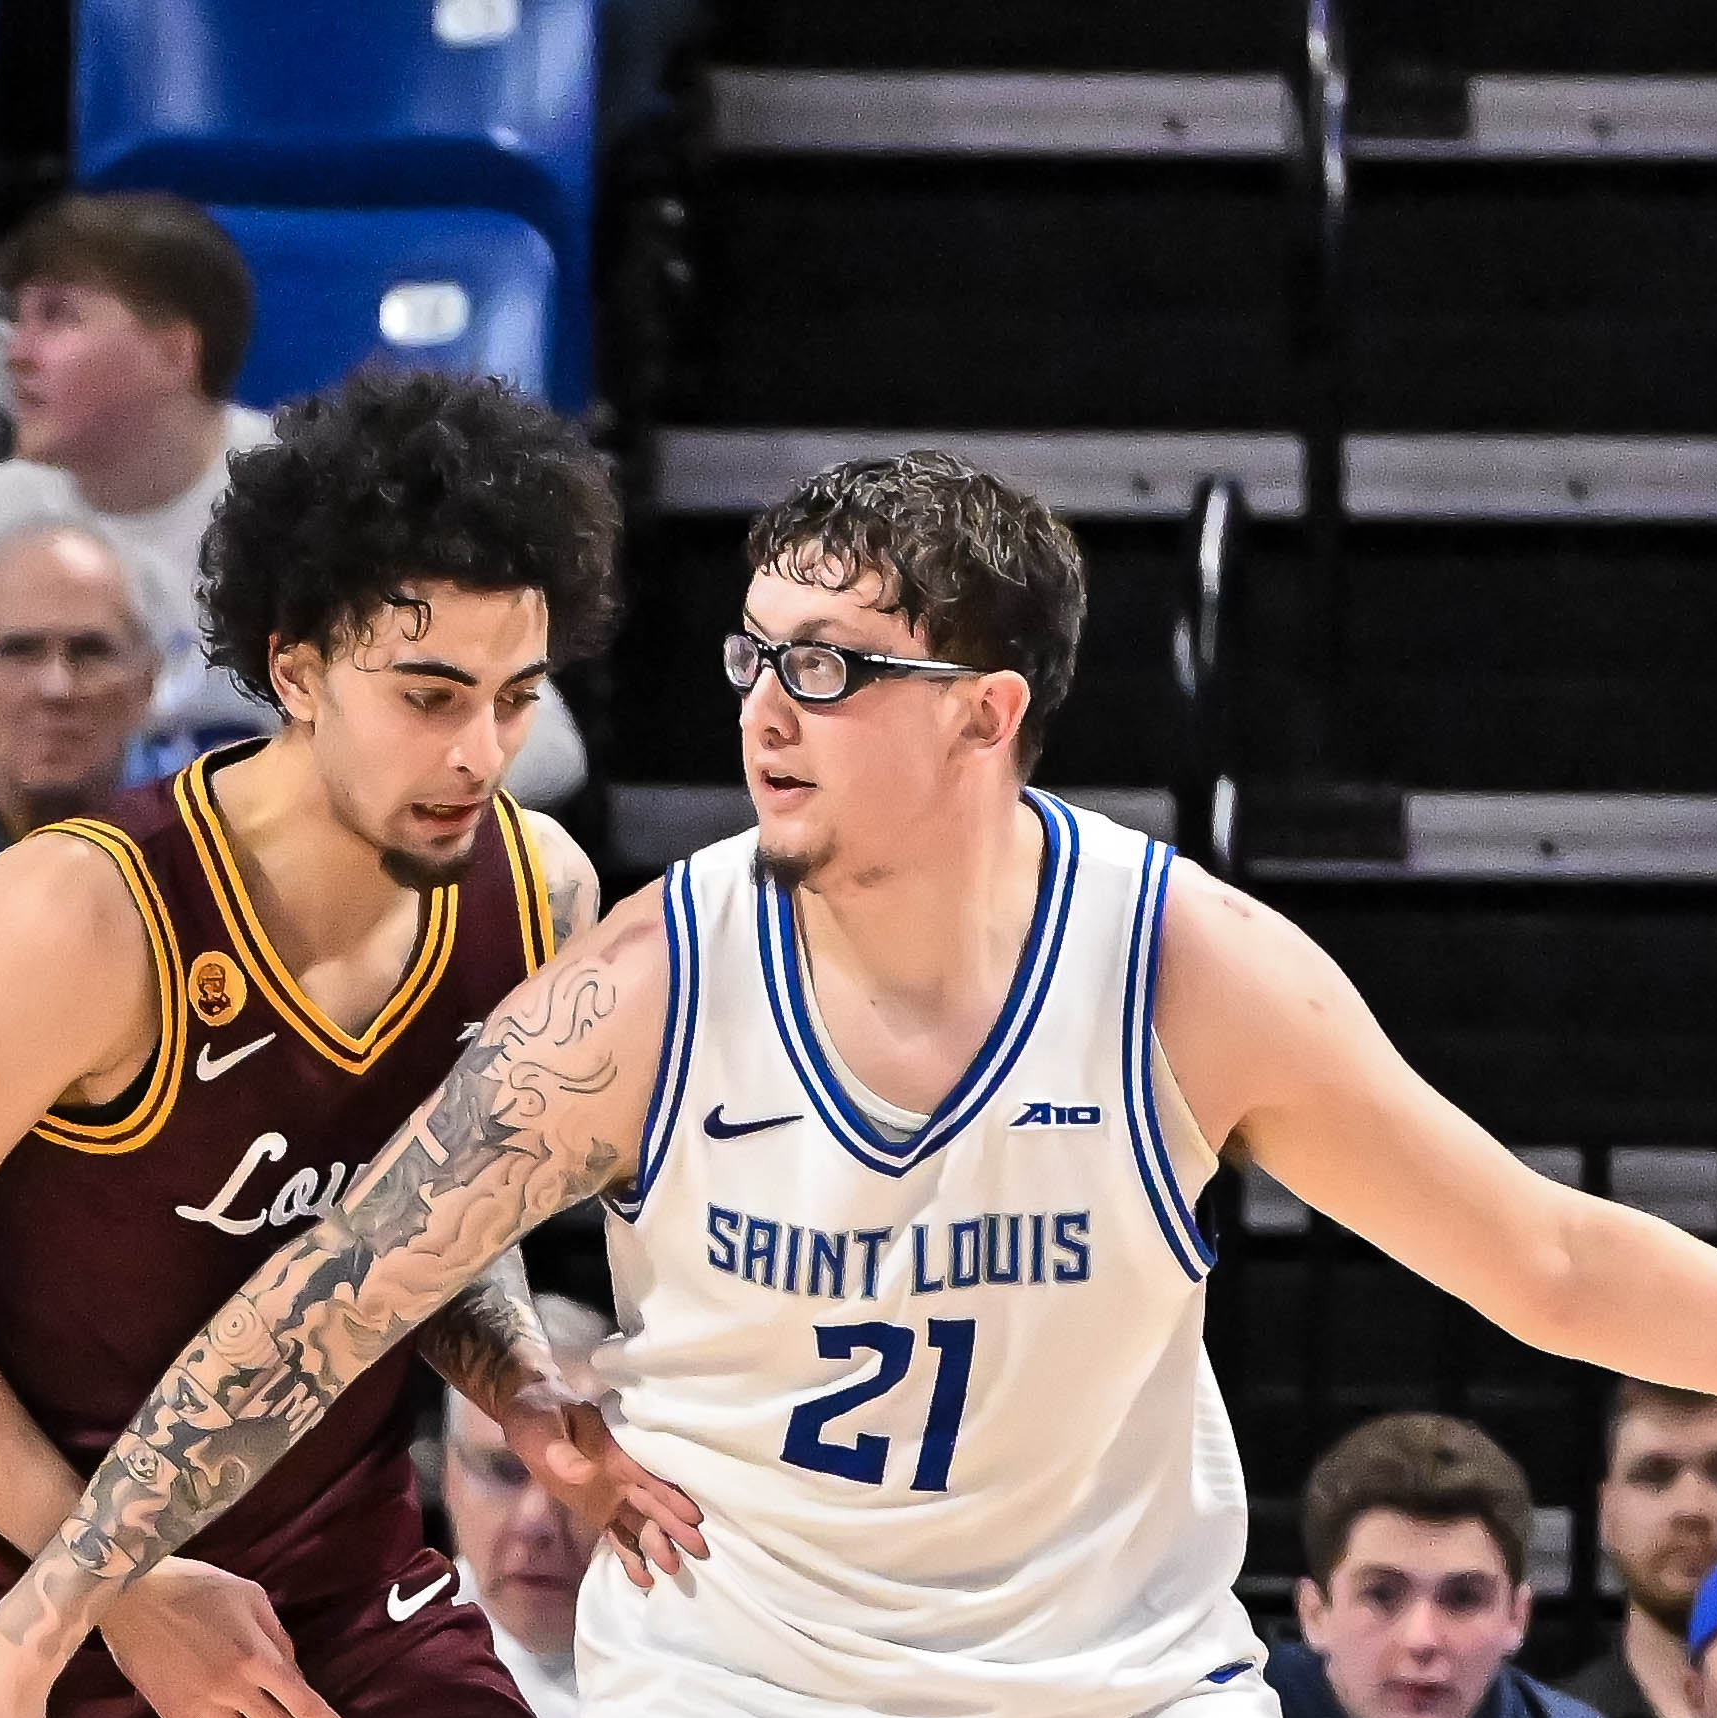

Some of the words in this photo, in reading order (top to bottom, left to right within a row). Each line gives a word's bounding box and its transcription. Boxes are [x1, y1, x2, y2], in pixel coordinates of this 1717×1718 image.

[1009, 1102, 1101, 1126] A10
[707, 1201, 894, 1300] SAINT
[910, 1210, 1091, 1295] LOUIS
[779, 1317, 977, 1493] 21
